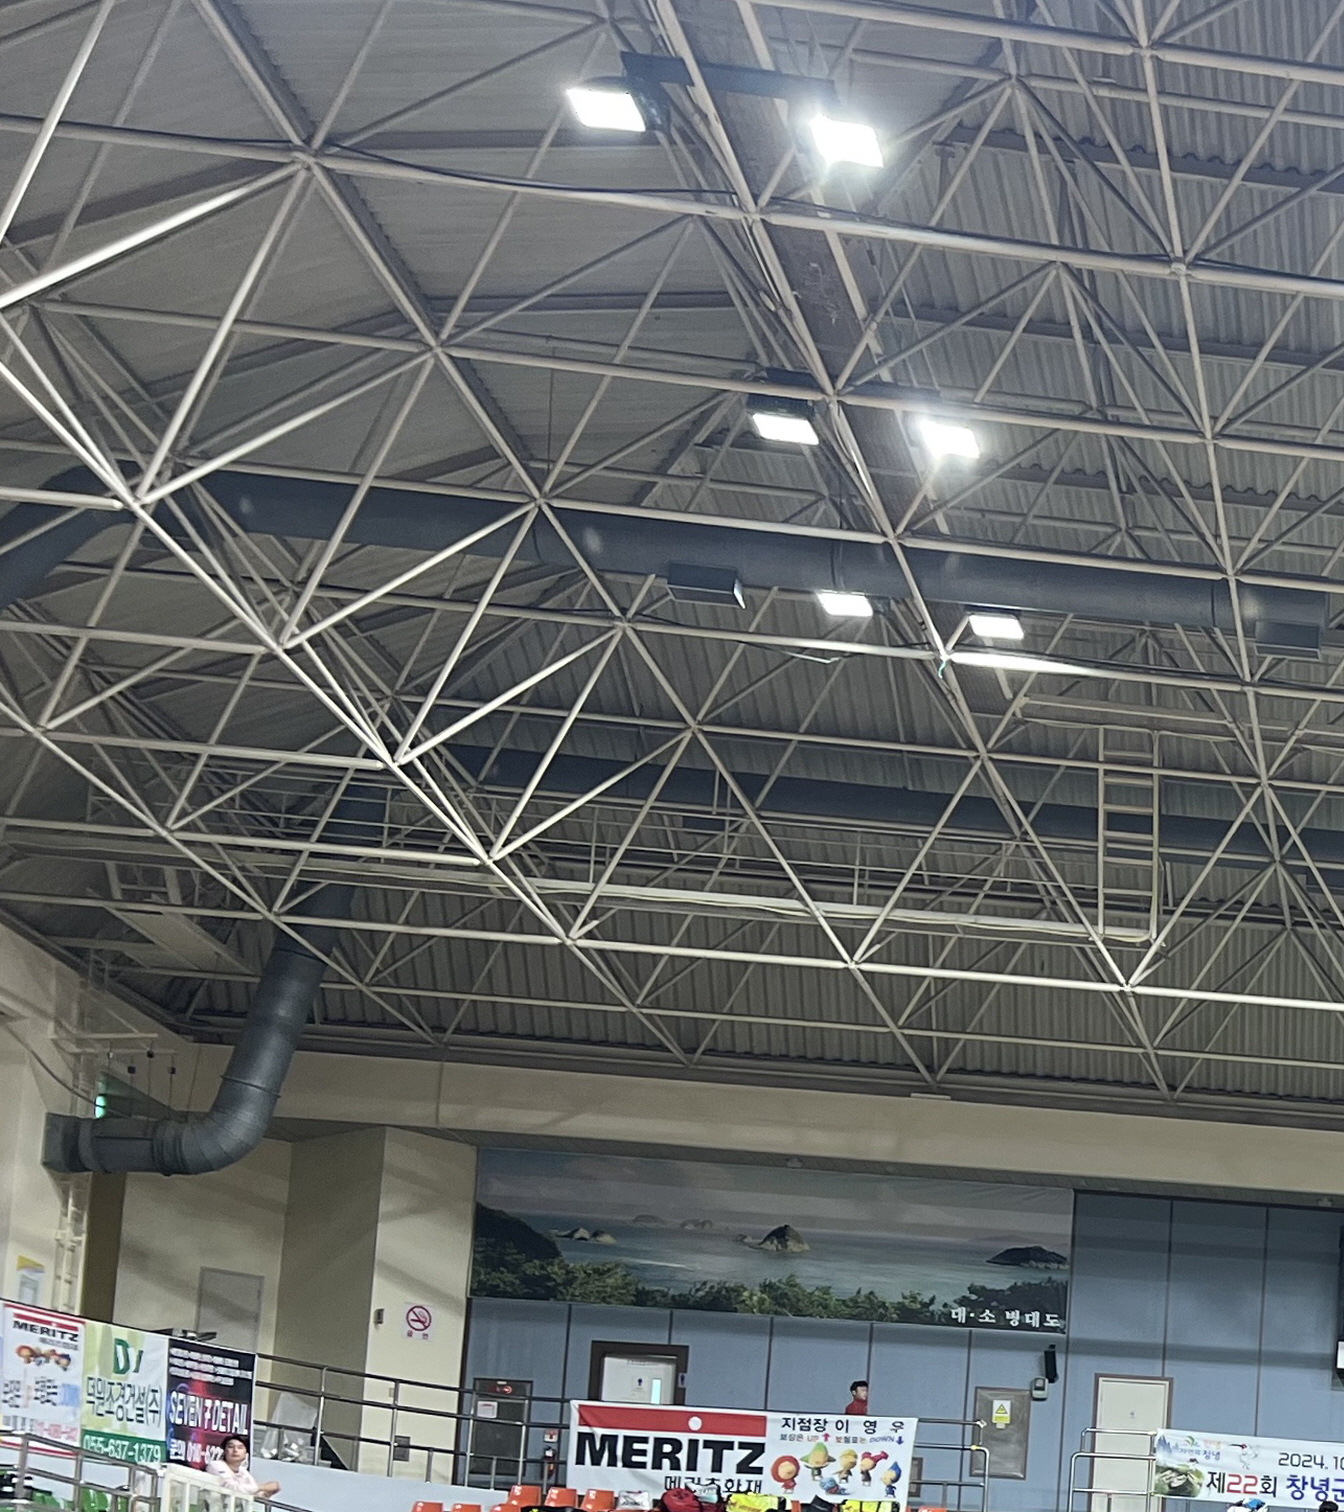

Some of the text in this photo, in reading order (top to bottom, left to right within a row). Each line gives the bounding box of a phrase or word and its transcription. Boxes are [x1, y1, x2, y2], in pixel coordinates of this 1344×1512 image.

[13, 1320, 79, 1342] MERITZ
[781, 1417, 828, 1432] 지점장
[83, 1434, 162, 1463] 055-637-1379
[575, 1431, 766, 1475] MERITZ
[1278, 1452, 1328, 1470] 2024.
[1206, 1470, 1278, 1498] 제22회
